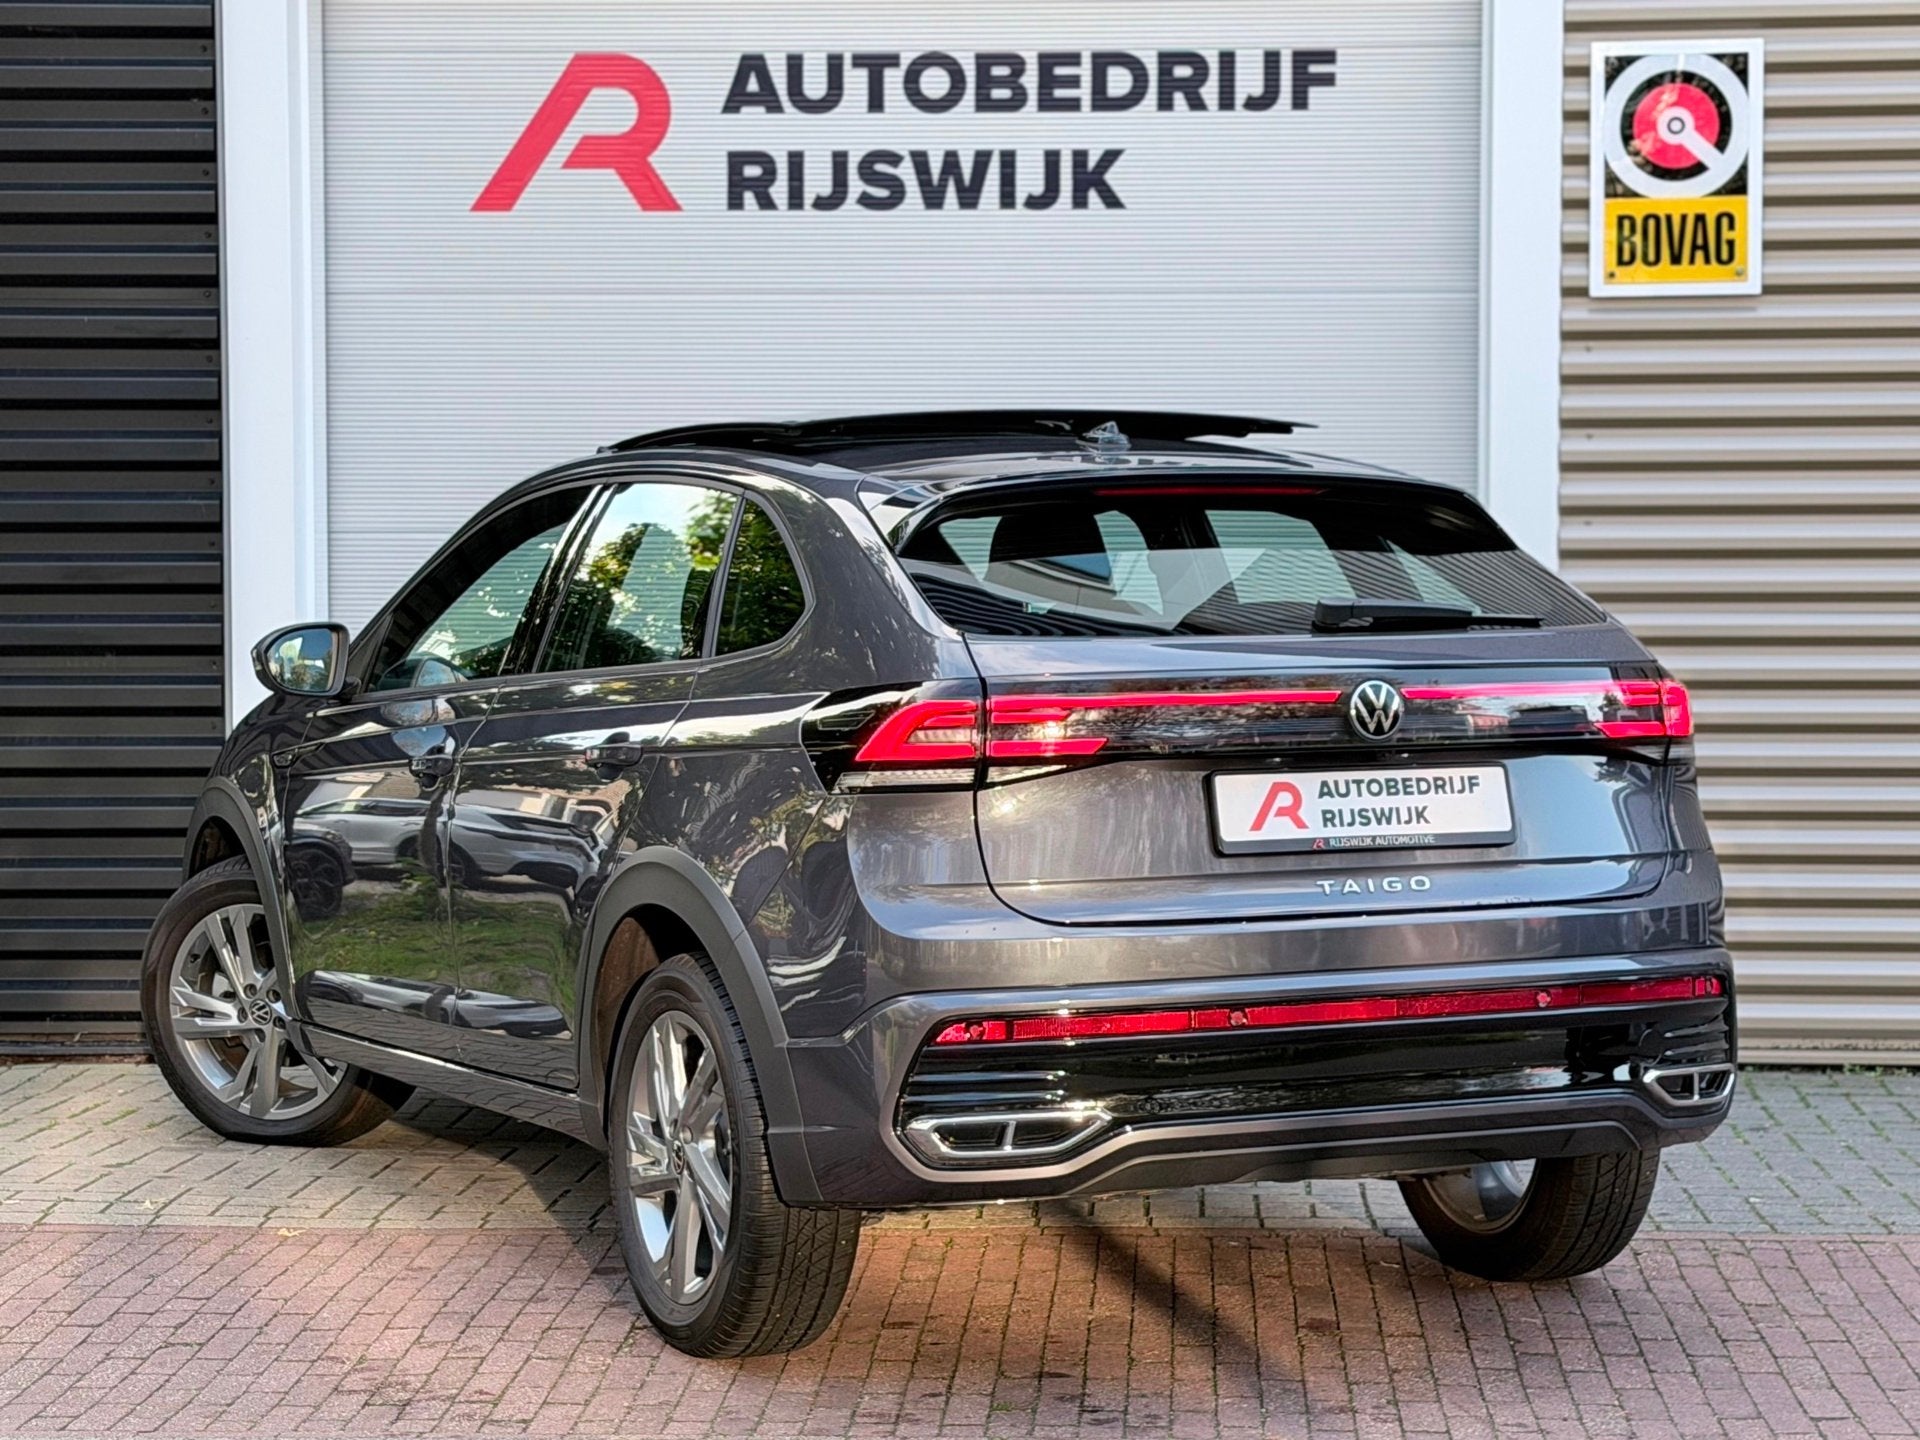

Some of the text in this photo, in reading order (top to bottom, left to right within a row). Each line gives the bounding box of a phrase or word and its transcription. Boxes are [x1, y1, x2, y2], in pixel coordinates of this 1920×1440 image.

[721, 49, 1337, 114] AUTOBEDRIJF
[727, 149, 1125, 211] RIJSWIJK
[1616, 211, 1736, 267] BOVAG
[1318, 775, 1480, 799] AUTOBEDRIJF
[1321, 805, 1431, 828] RIJSWIJK
[1329, 834, 1436, 849] RIJSWIJK AUTOMOTIVE
[1315, 875, 1431, 895] TAIGO
